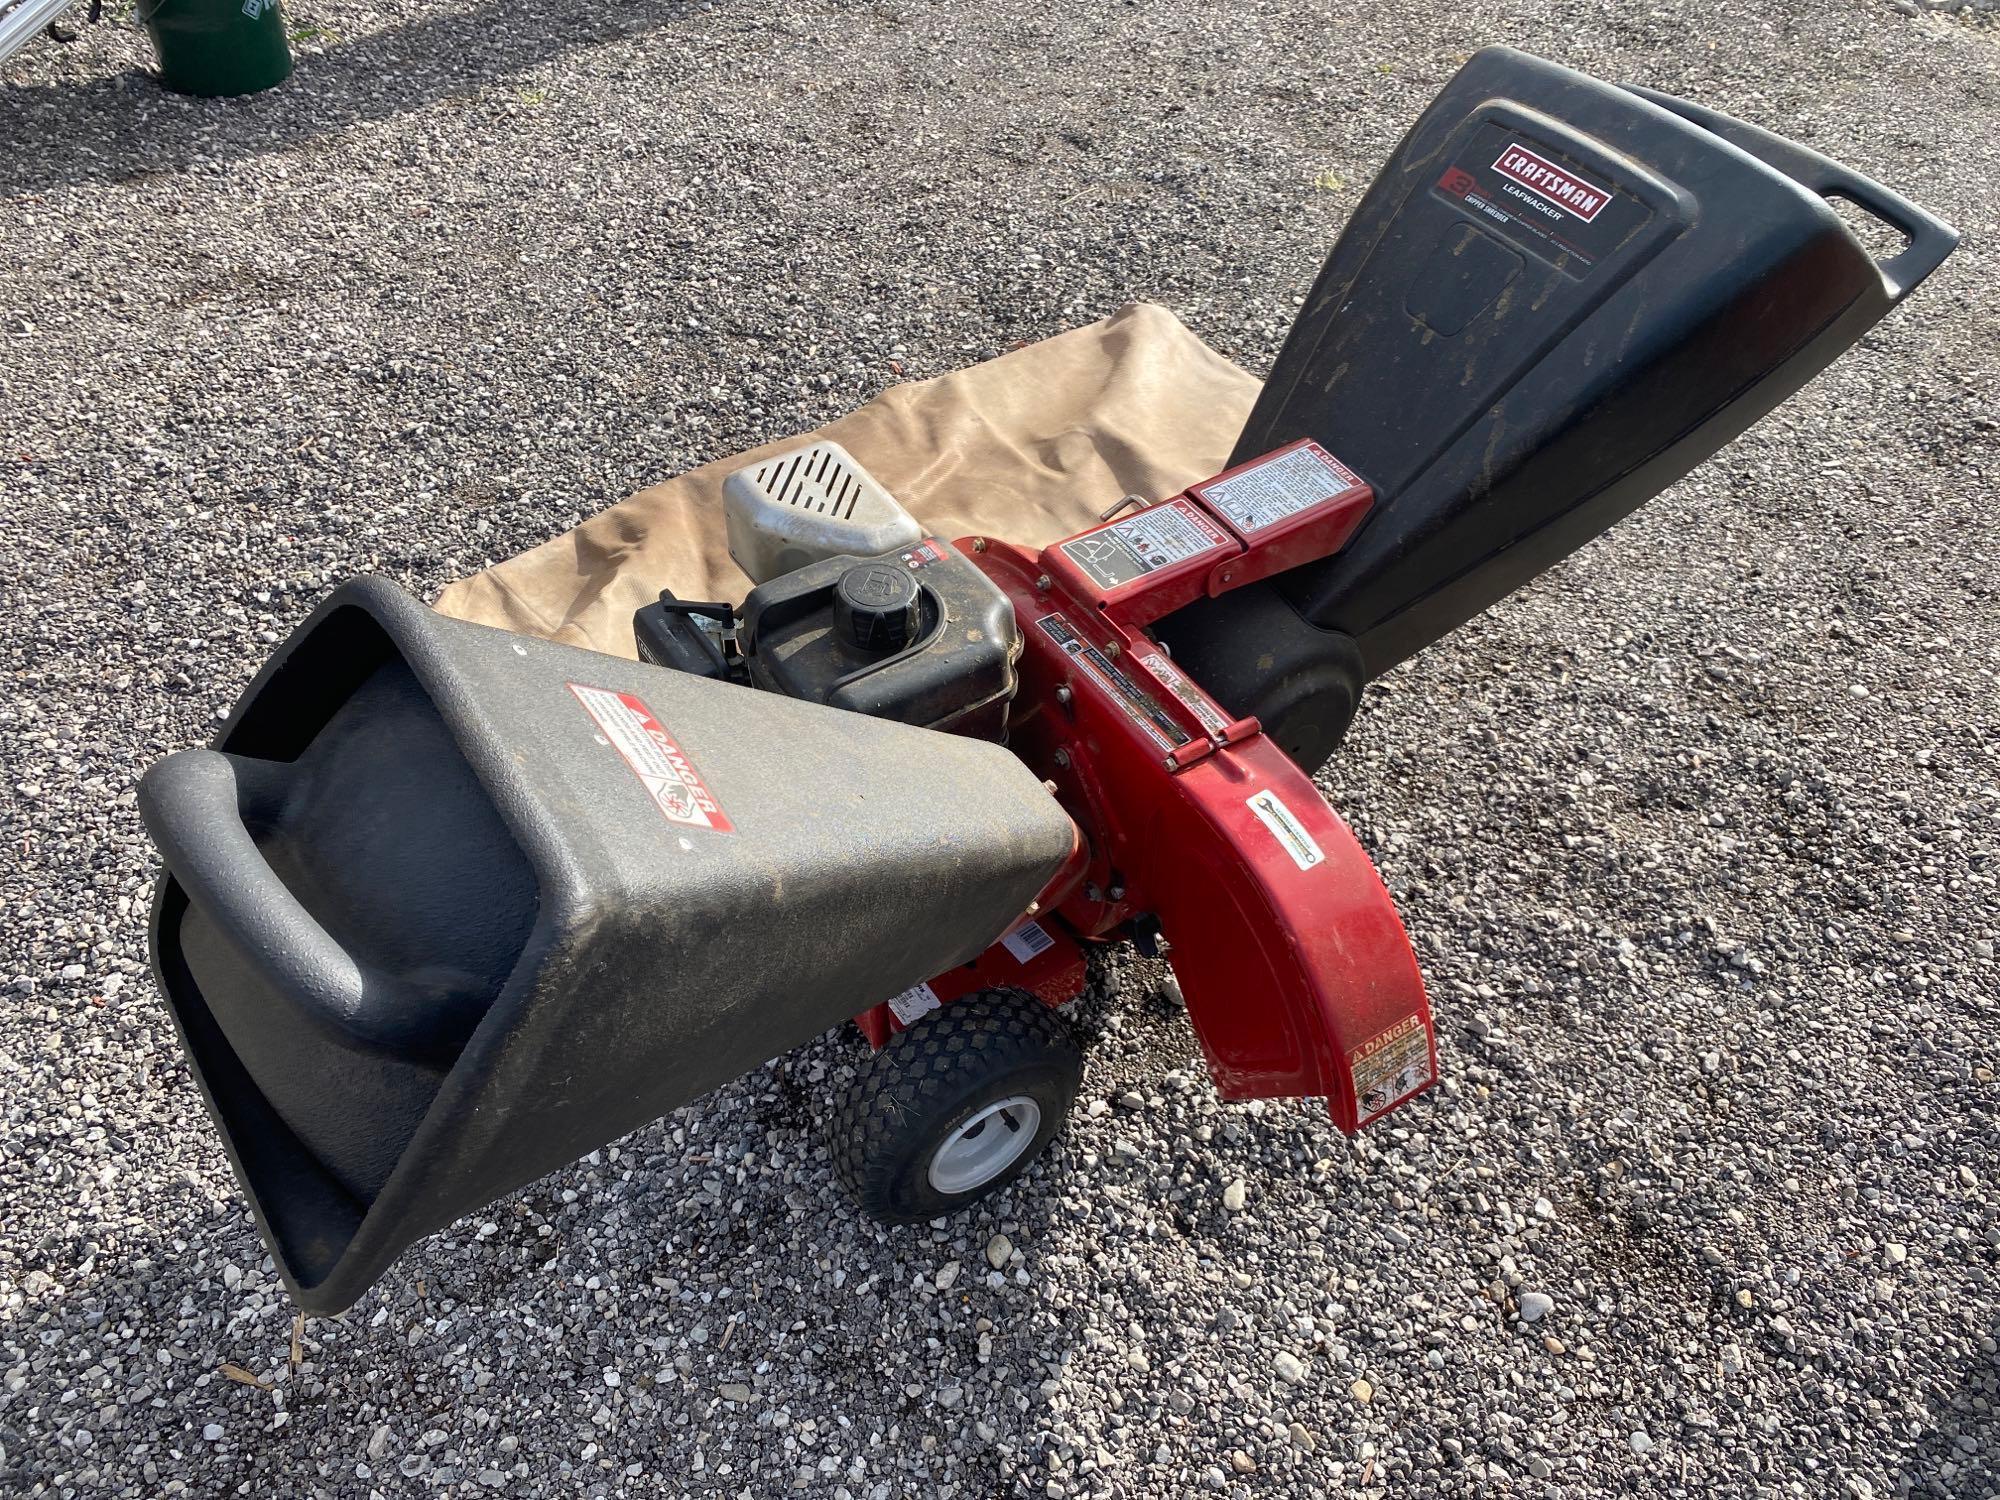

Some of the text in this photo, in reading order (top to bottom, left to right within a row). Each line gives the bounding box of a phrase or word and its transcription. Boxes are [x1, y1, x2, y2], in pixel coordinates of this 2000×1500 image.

[1502, 183, 1563, 221] LEAFWACKER
[1503, 152, 1600, 214] CRAFTSMAN
[1321, 453, 1354, 482] DANGER
[1186, 511, 1218, 540] DANGER
[647, 729, 718, 813] DANGER
[1364, 1014, 1421, 1056] DANGER
